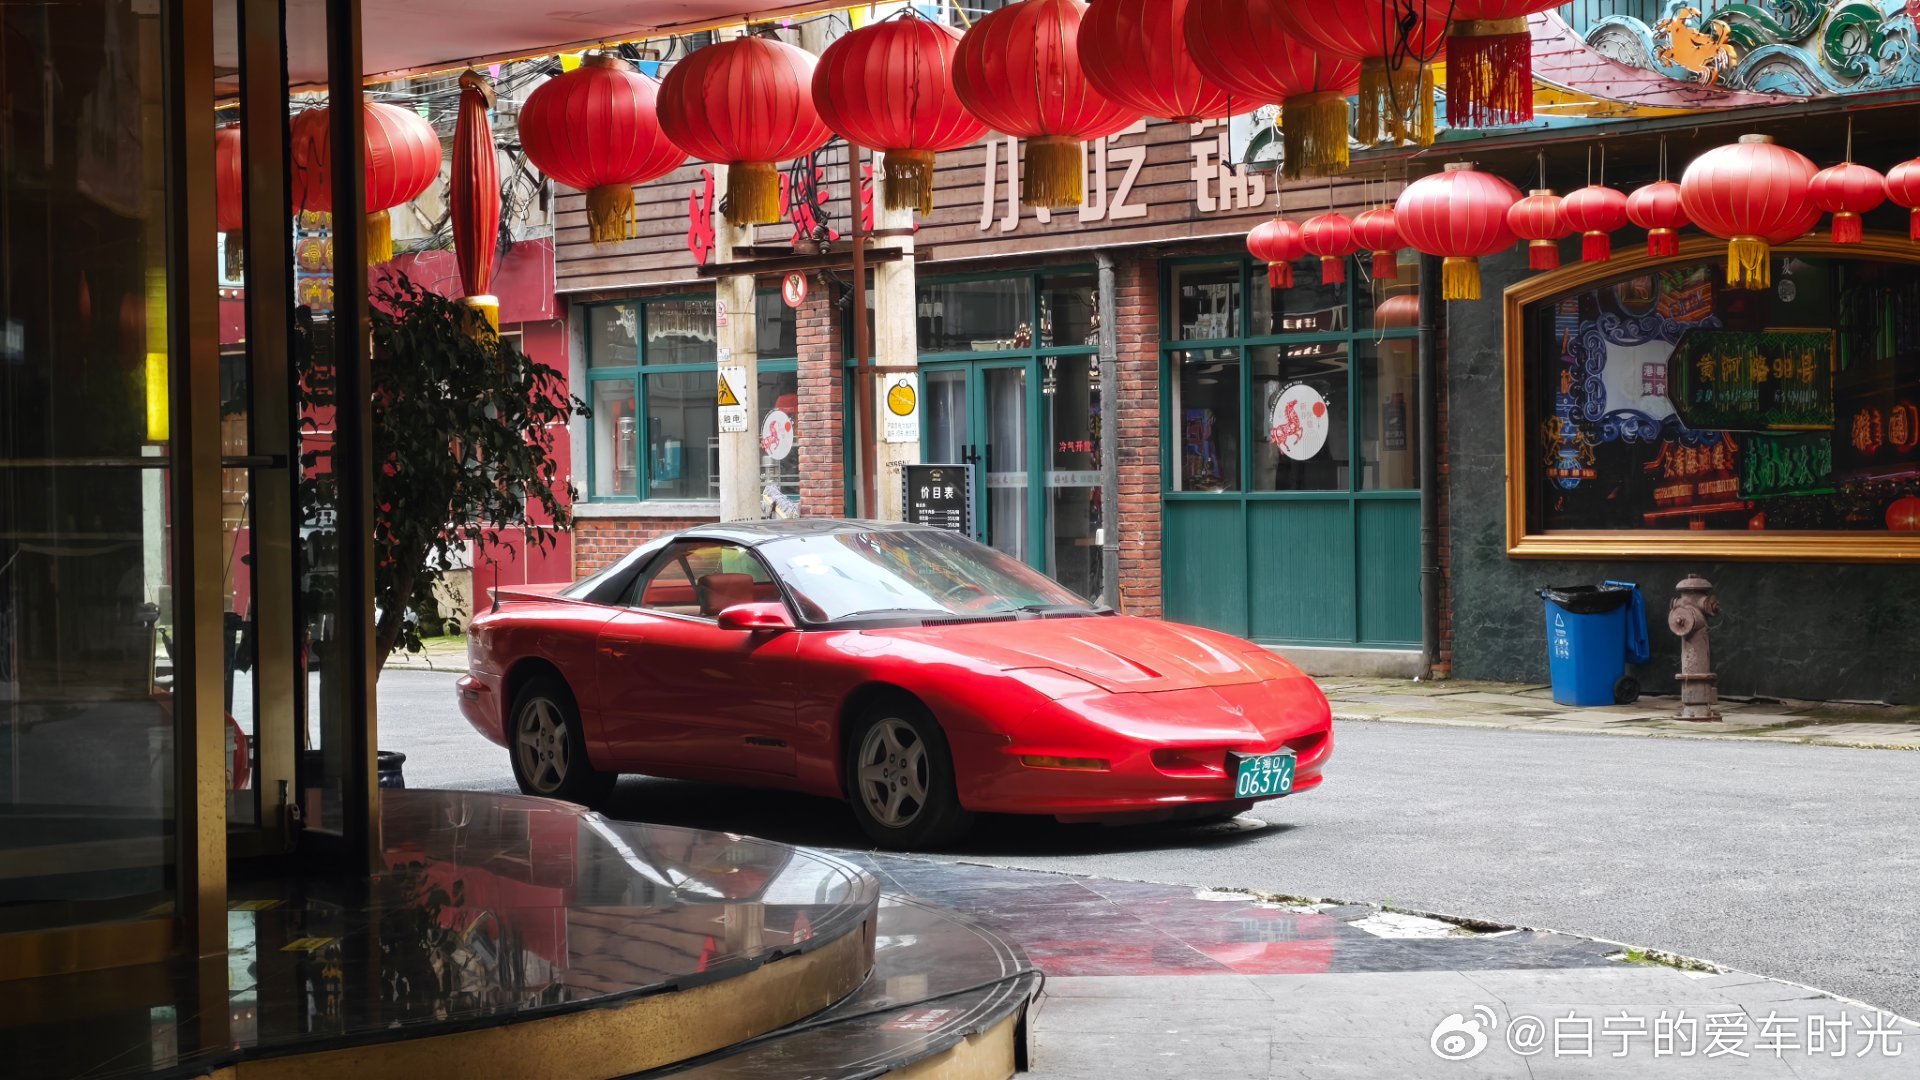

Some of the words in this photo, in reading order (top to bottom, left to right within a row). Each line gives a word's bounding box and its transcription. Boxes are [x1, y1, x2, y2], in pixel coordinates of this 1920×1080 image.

[920, 486, 955, 500] 价目表
[1238, 767, 1291, 796] 06376
